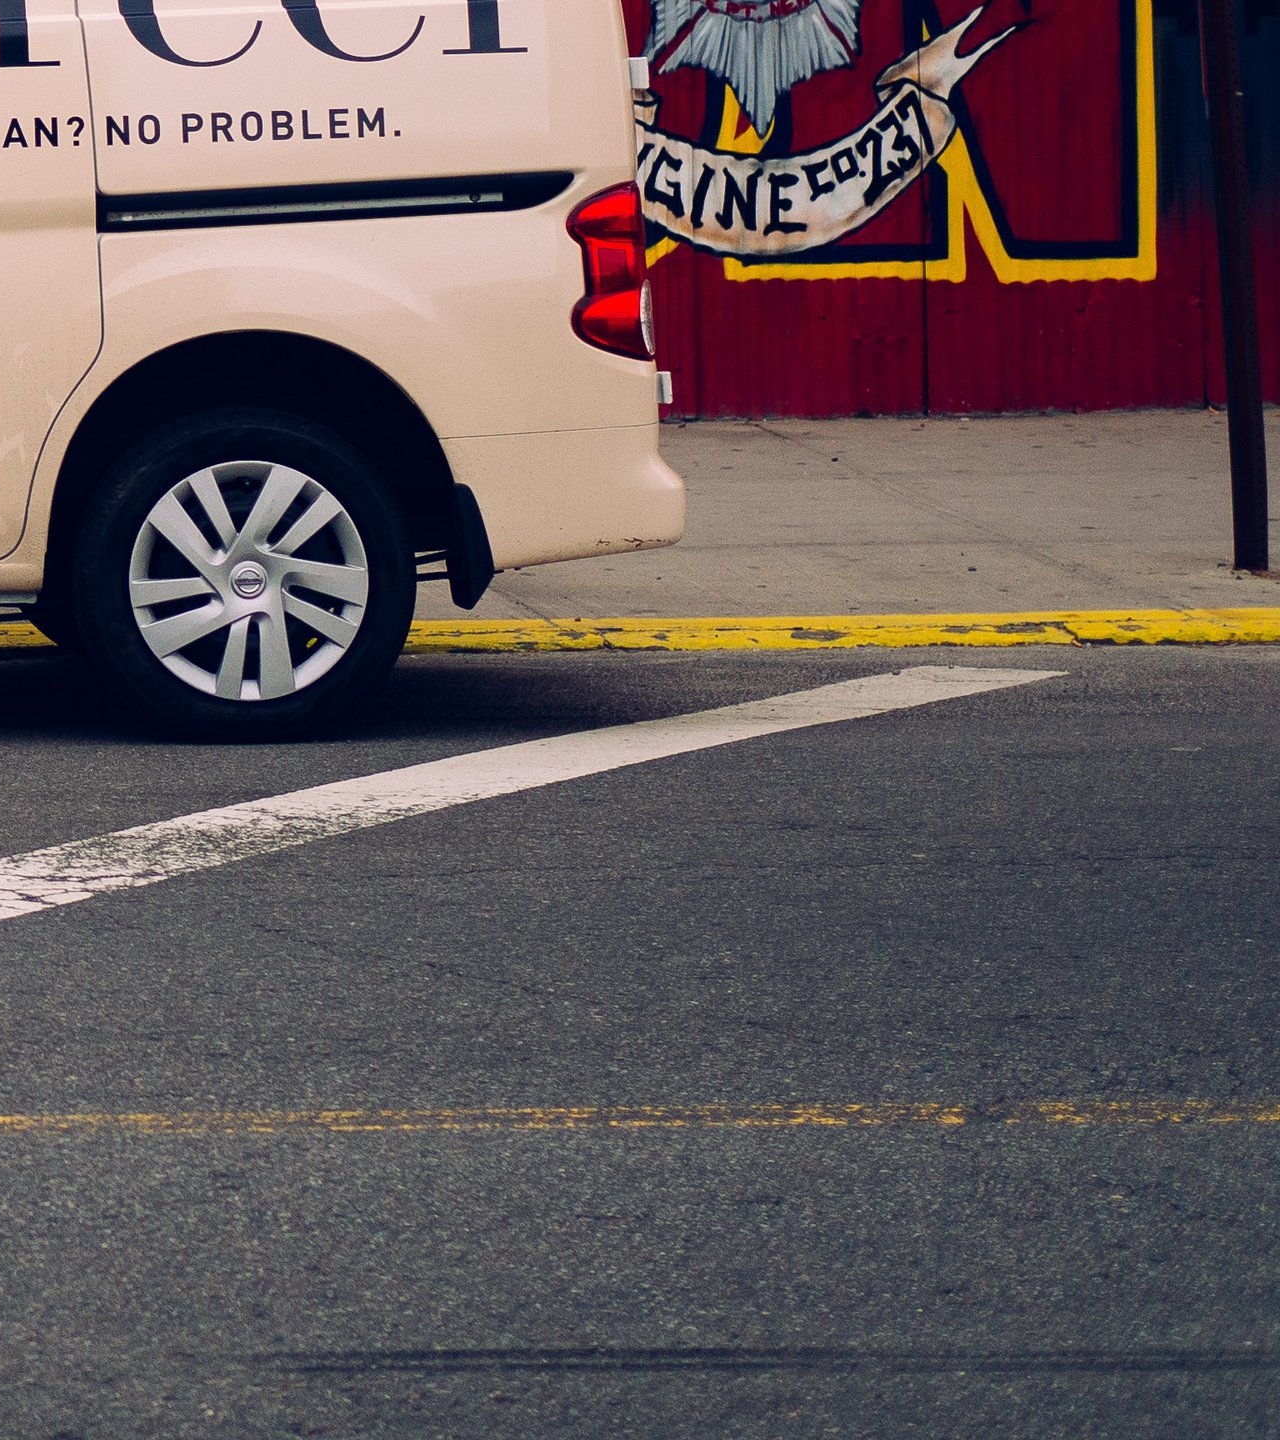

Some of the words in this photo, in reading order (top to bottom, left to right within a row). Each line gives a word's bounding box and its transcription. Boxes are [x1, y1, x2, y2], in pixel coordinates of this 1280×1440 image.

[105, 114, 162, 147] NO
[181, 107, 403, 145] PROBLEM.
[855, 89, 935, 208] 237
